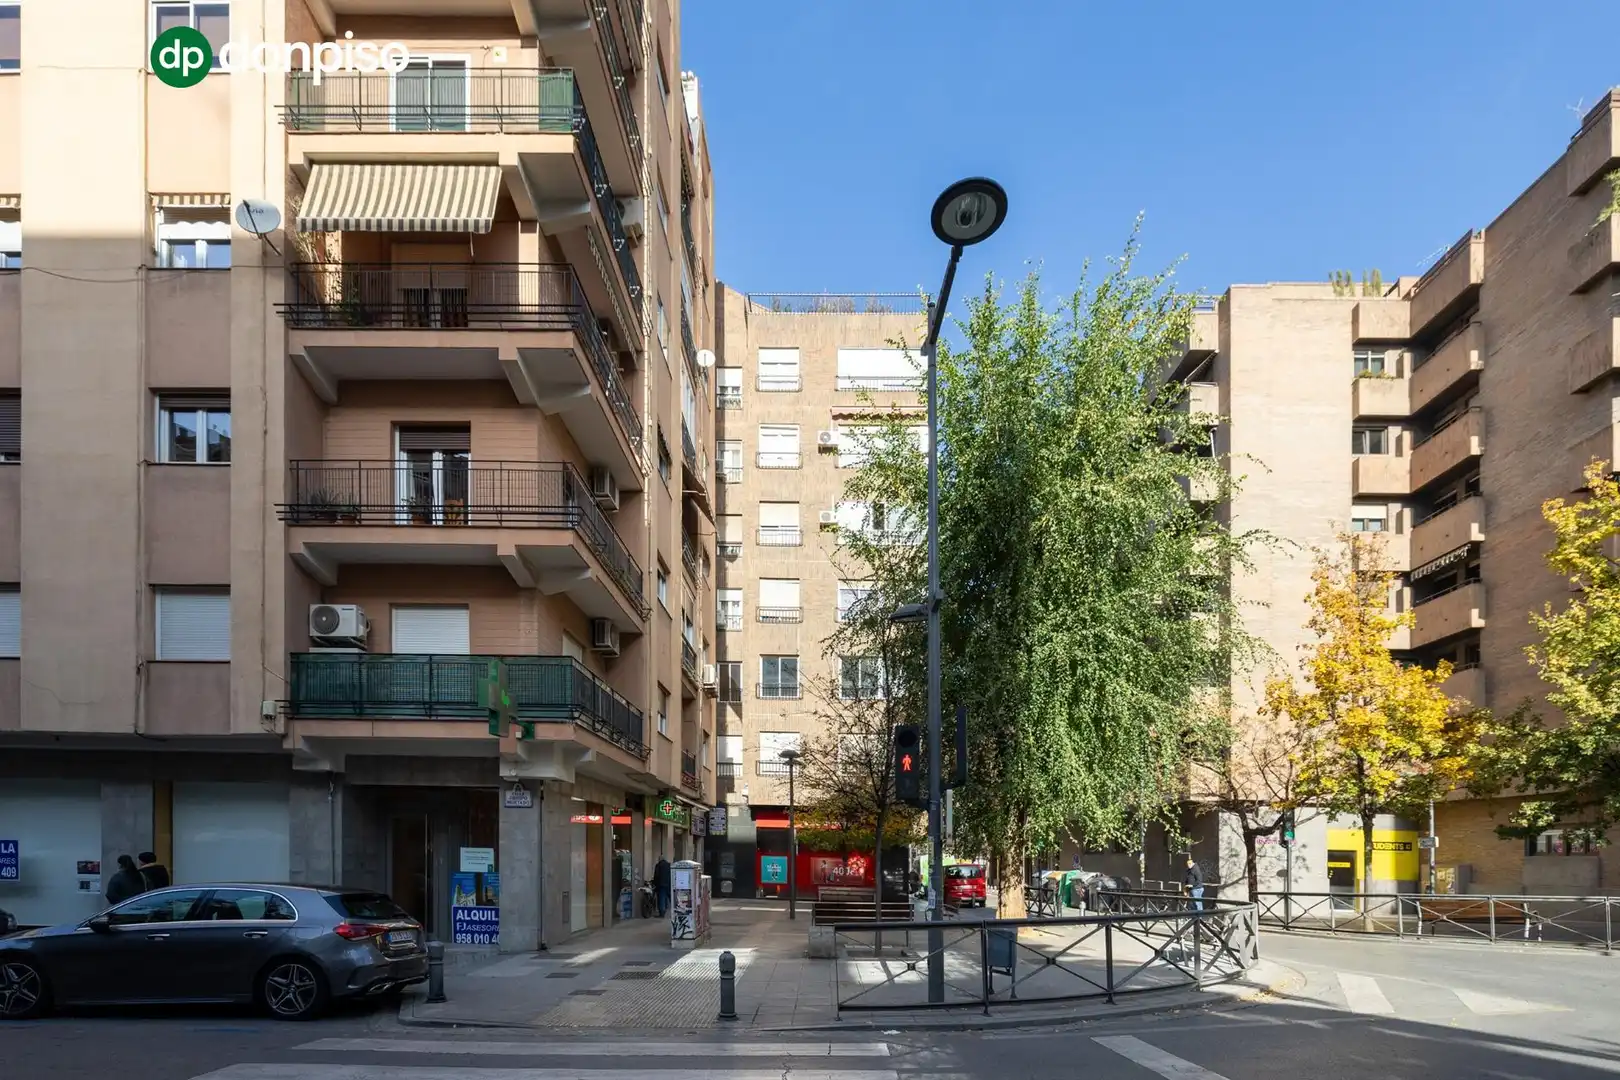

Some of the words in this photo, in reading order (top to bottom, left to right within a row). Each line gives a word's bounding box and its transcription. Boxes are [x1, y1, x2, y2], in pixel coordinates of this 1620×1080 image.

[1, 843, 16, 854] LA
[1, 866, 17, 878] 409
[456, 933, 472, 944] 958
[474, 933, 490, 944] 010
